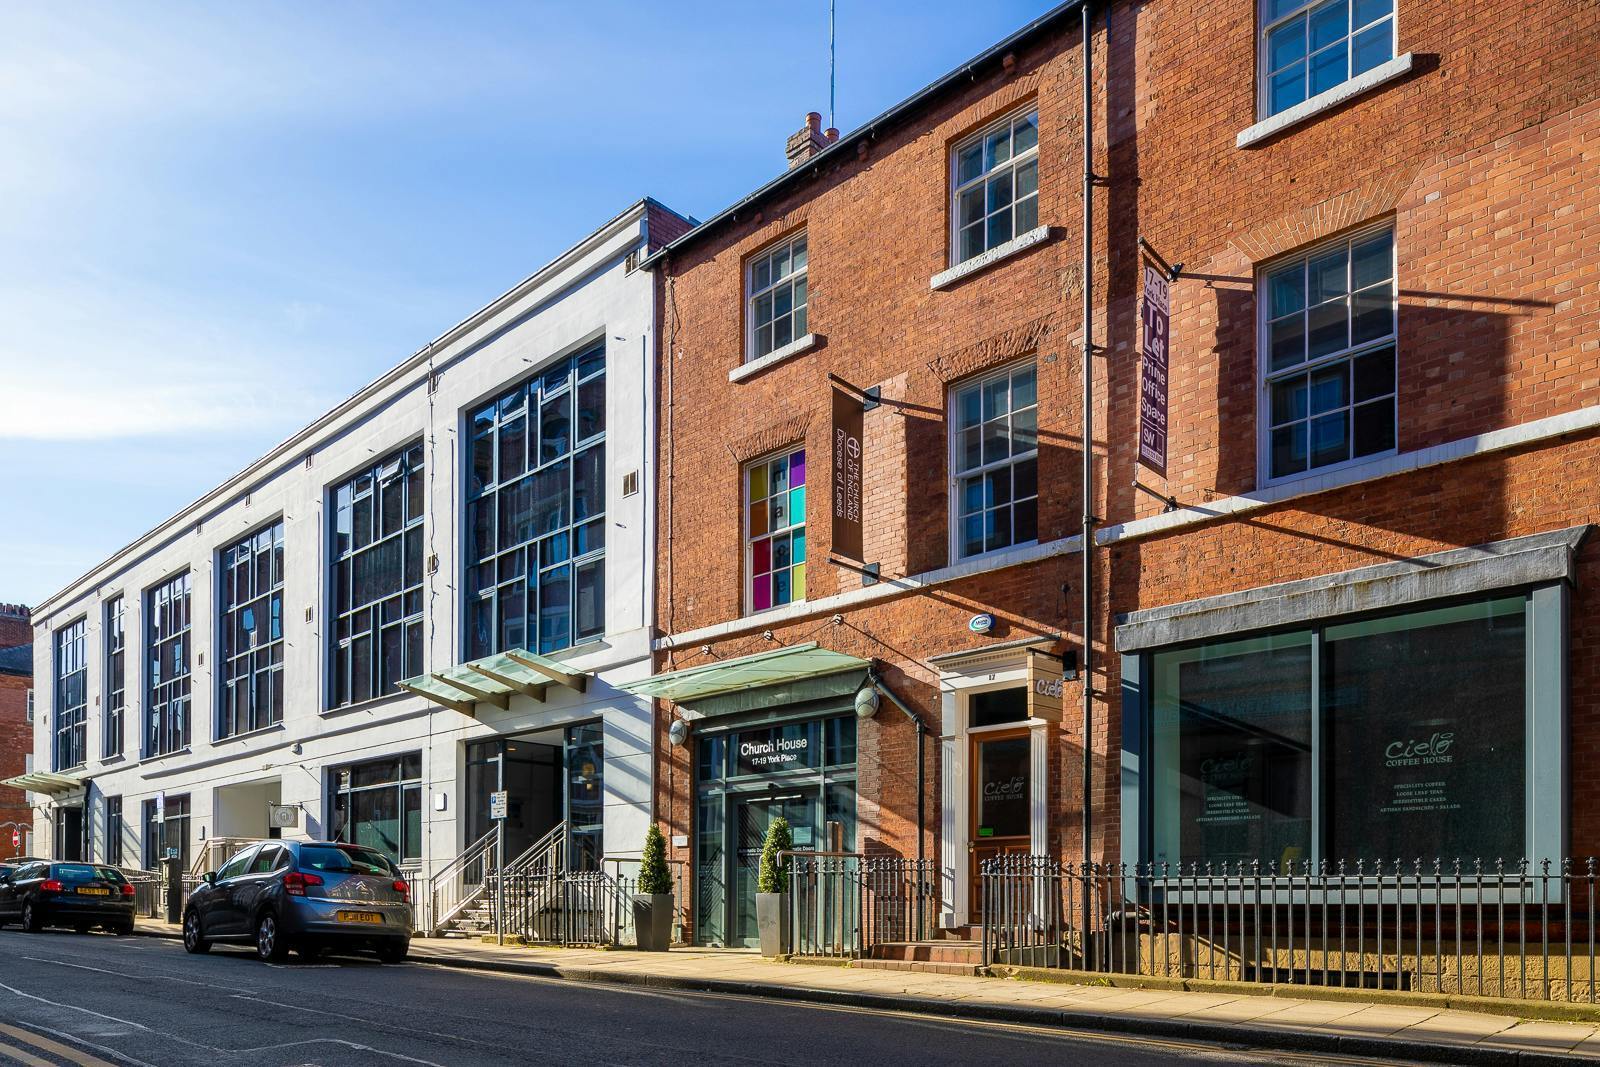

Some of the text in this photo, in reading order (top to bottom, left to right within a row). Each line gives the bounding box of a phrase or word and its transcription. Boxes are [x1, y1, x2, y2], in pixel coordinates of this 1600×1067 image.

[1144, 266, 1167, 299] 17-19
[1147, 300, 1163, 335] To
[1144, 324, 1164, 363] Let
[1142, 356, 1165, 386] Prime
[1142, 376, 1165, 406] Office
[1141, 396, 1165, 425] Space
[836, 428, 844, 517] Diocese of Leeds
[847, 458, 853, 472] OF
[741, 738, 808, 756] Church House
[752, 754, 797, 765] 17-19 York Place
[1385, 732, 1454, 758] Cielo
[1385, 755, 1453, 767] COFFEE HOUSE
[984, 776, 1025, 795] Cielo
